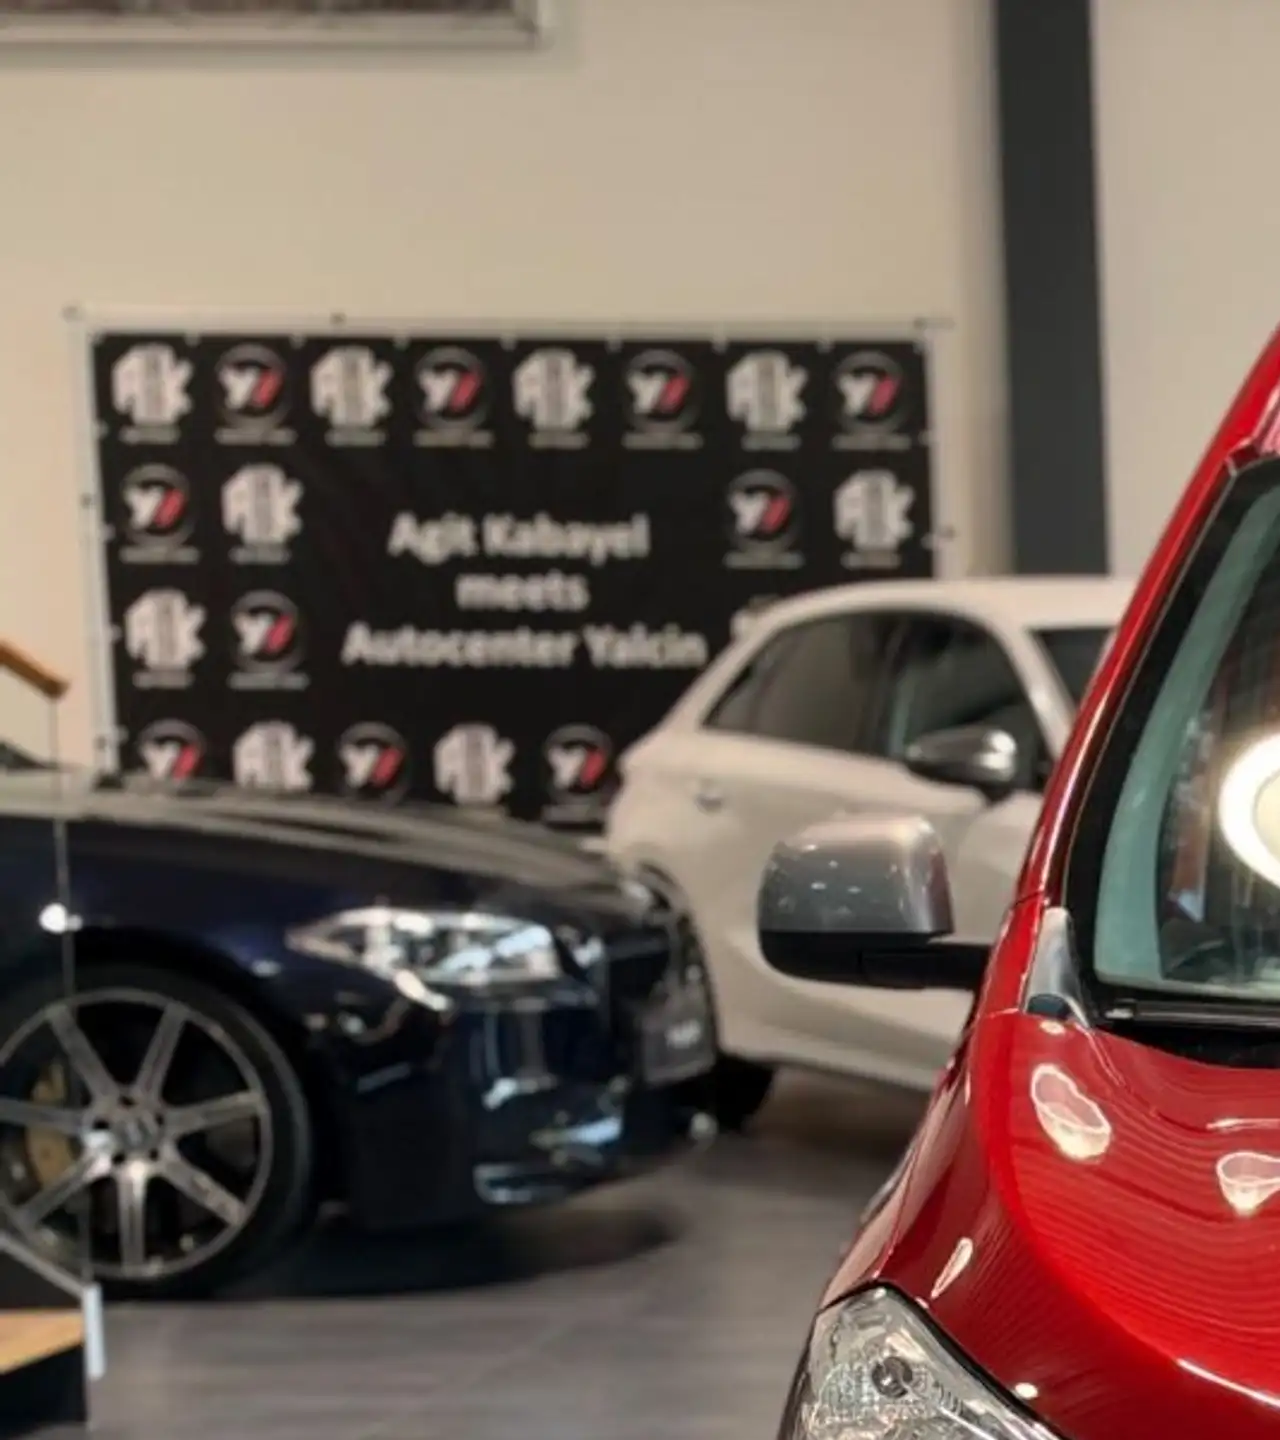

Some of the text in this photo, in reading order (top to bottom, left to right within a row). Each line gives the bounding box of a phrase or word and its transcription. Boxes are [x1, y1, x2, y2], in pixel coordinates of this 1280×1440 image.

[388, 512, 650, 566] Agit Kabayel
[455, 570, 590, 612] meets
[342, 622, 708, 668] Autocenter Yalcin
